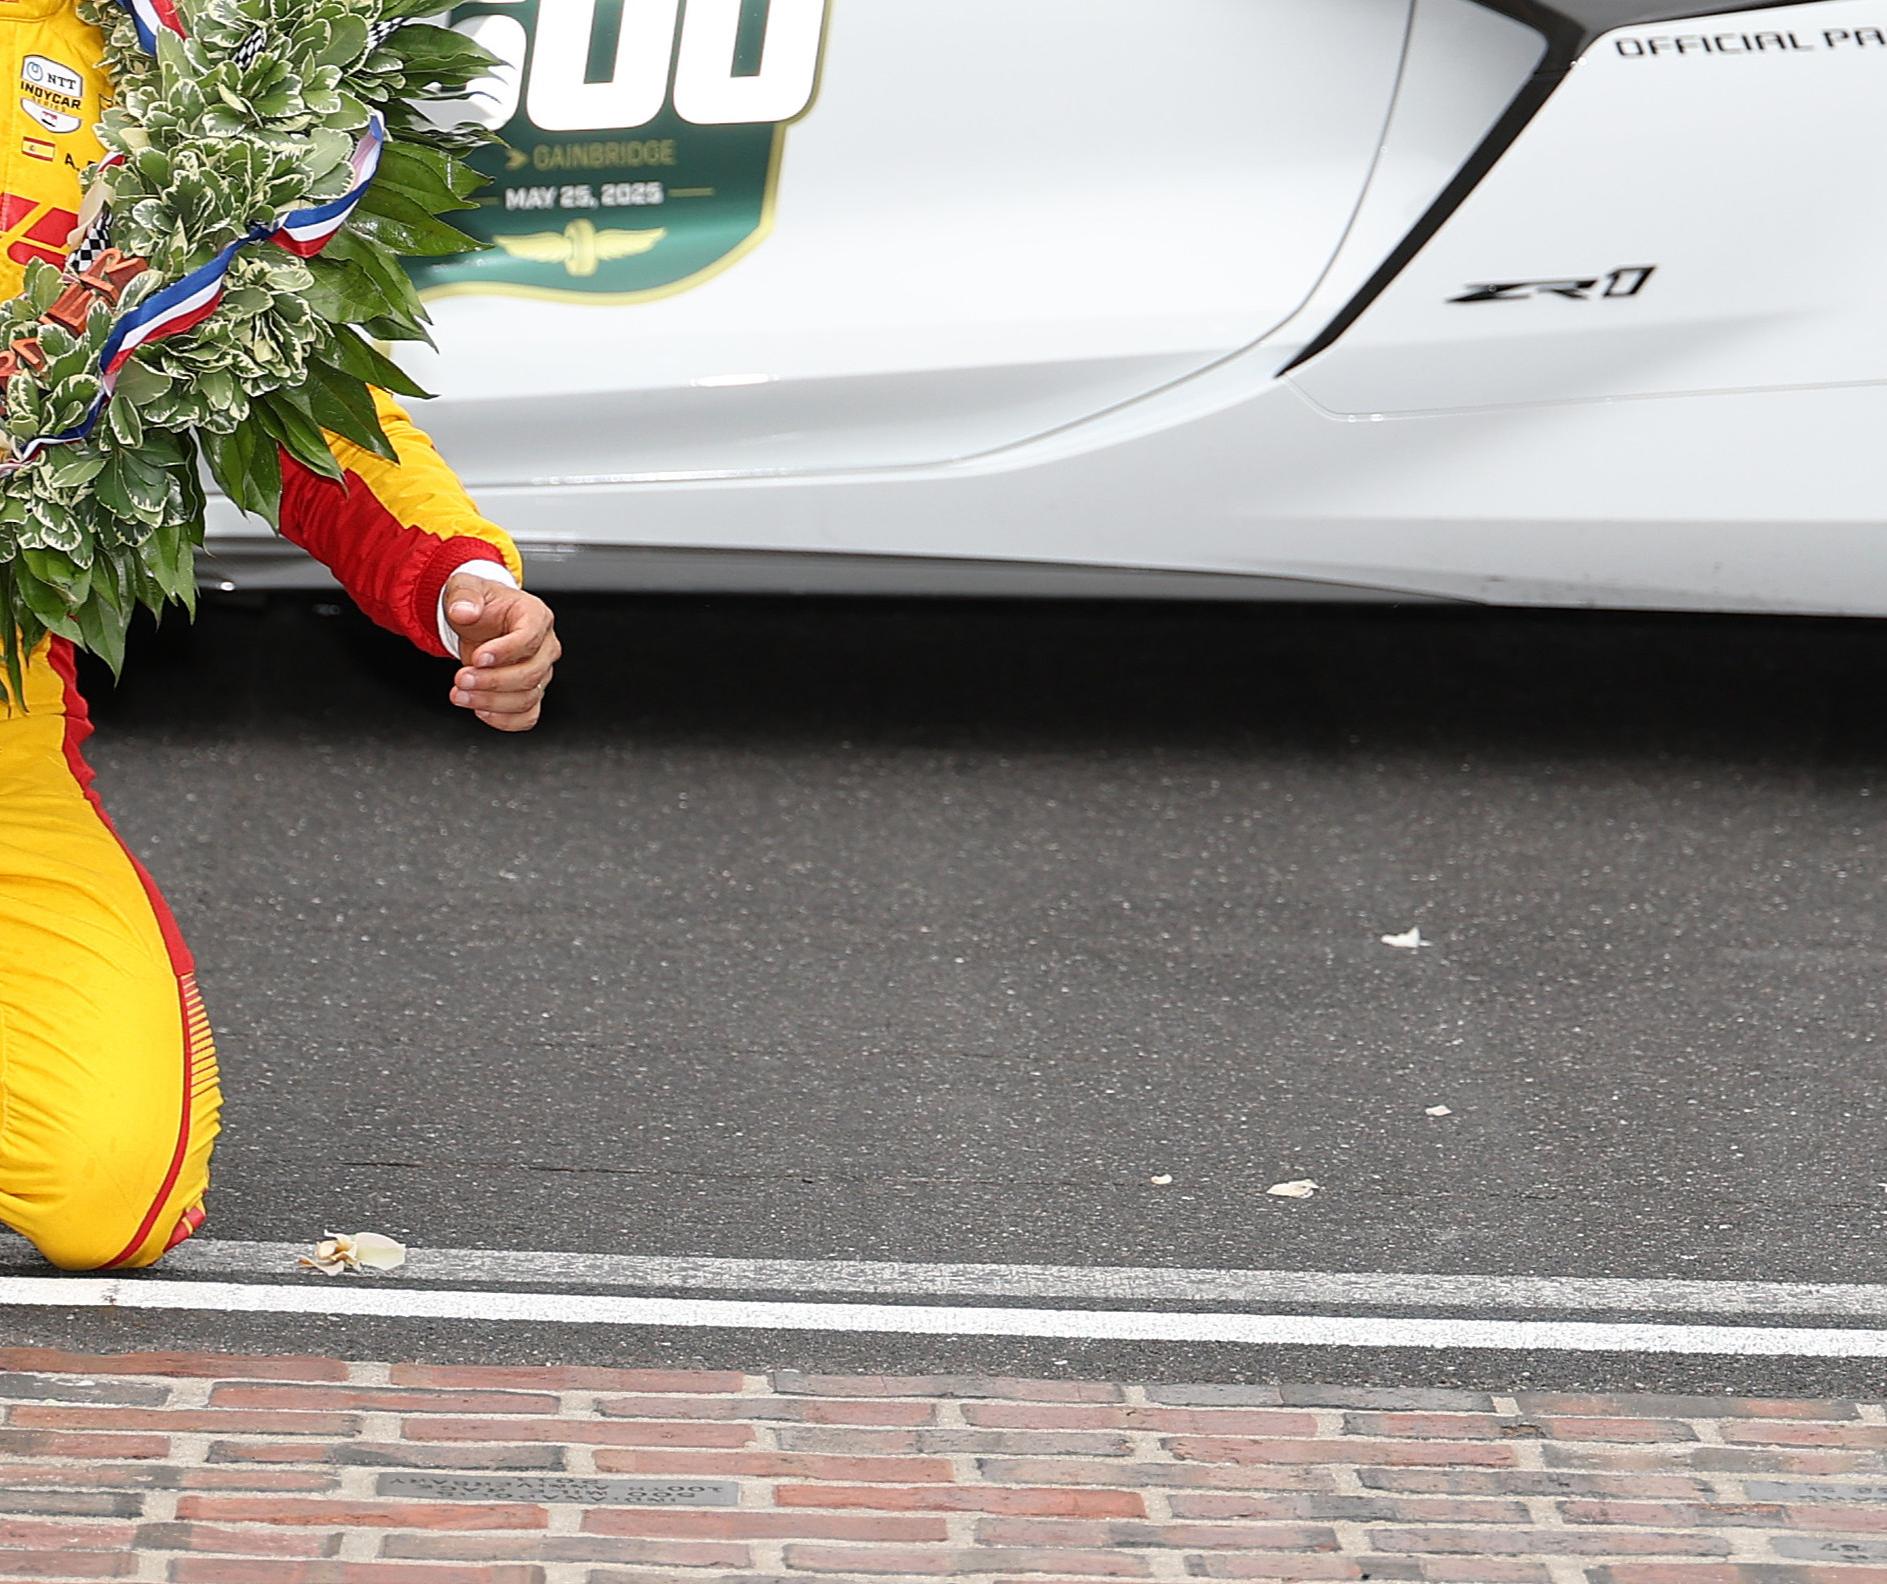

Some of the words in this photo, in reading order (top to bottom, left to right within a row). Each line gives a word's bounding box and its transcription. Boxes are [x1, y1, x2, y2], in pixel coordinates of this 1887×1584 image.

[1614, 30, 1815, 59] OFFICIAL
[20, 80, 81, 110] INDYCAR
[47, 72, 76, 90] NTT
[533, 138, 676, 170] GAINBRIDGE
[505, 186, 557, 211] MAY
[559, 185, 598, 210] 25,
[601, 182, 664, 206] 2025
[435, 1491, 676, 1504] INDIANAPOLIS
